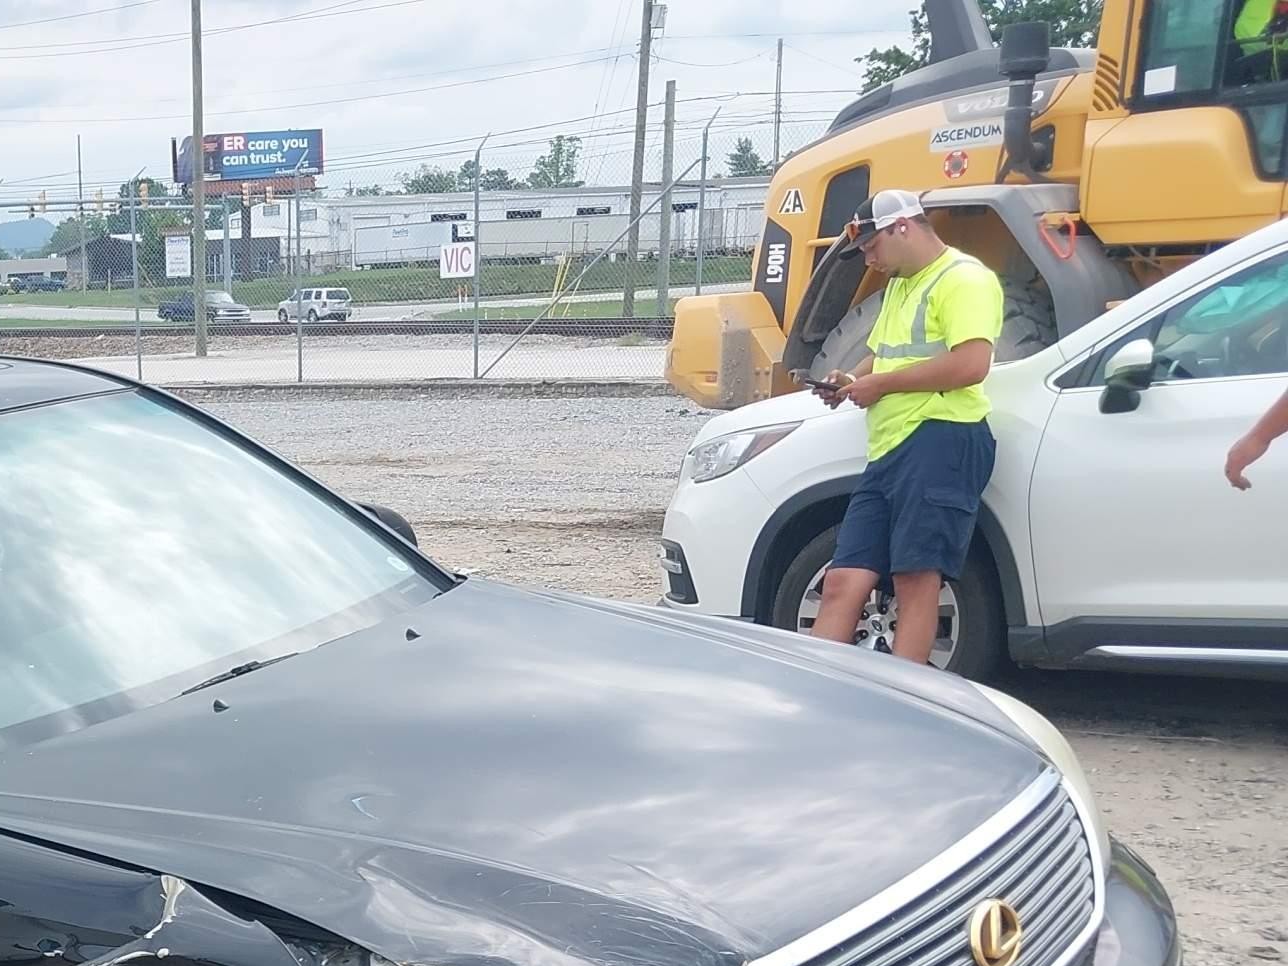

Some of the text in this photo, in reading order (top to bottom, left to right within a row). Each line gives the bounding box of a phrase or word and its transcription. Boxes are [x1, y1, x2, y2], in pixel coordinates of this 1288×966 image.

[930, 125, 1002, 144] ASCENDUM
[223, 136, 244, 150] ER
[248, 139, 278, 150] care
[282, 138, 308, 153] you
[222, 151, 286, 165] can trust.
[444, 246, 472, 273] VIC
[766, 243, 786, 283] L90H
